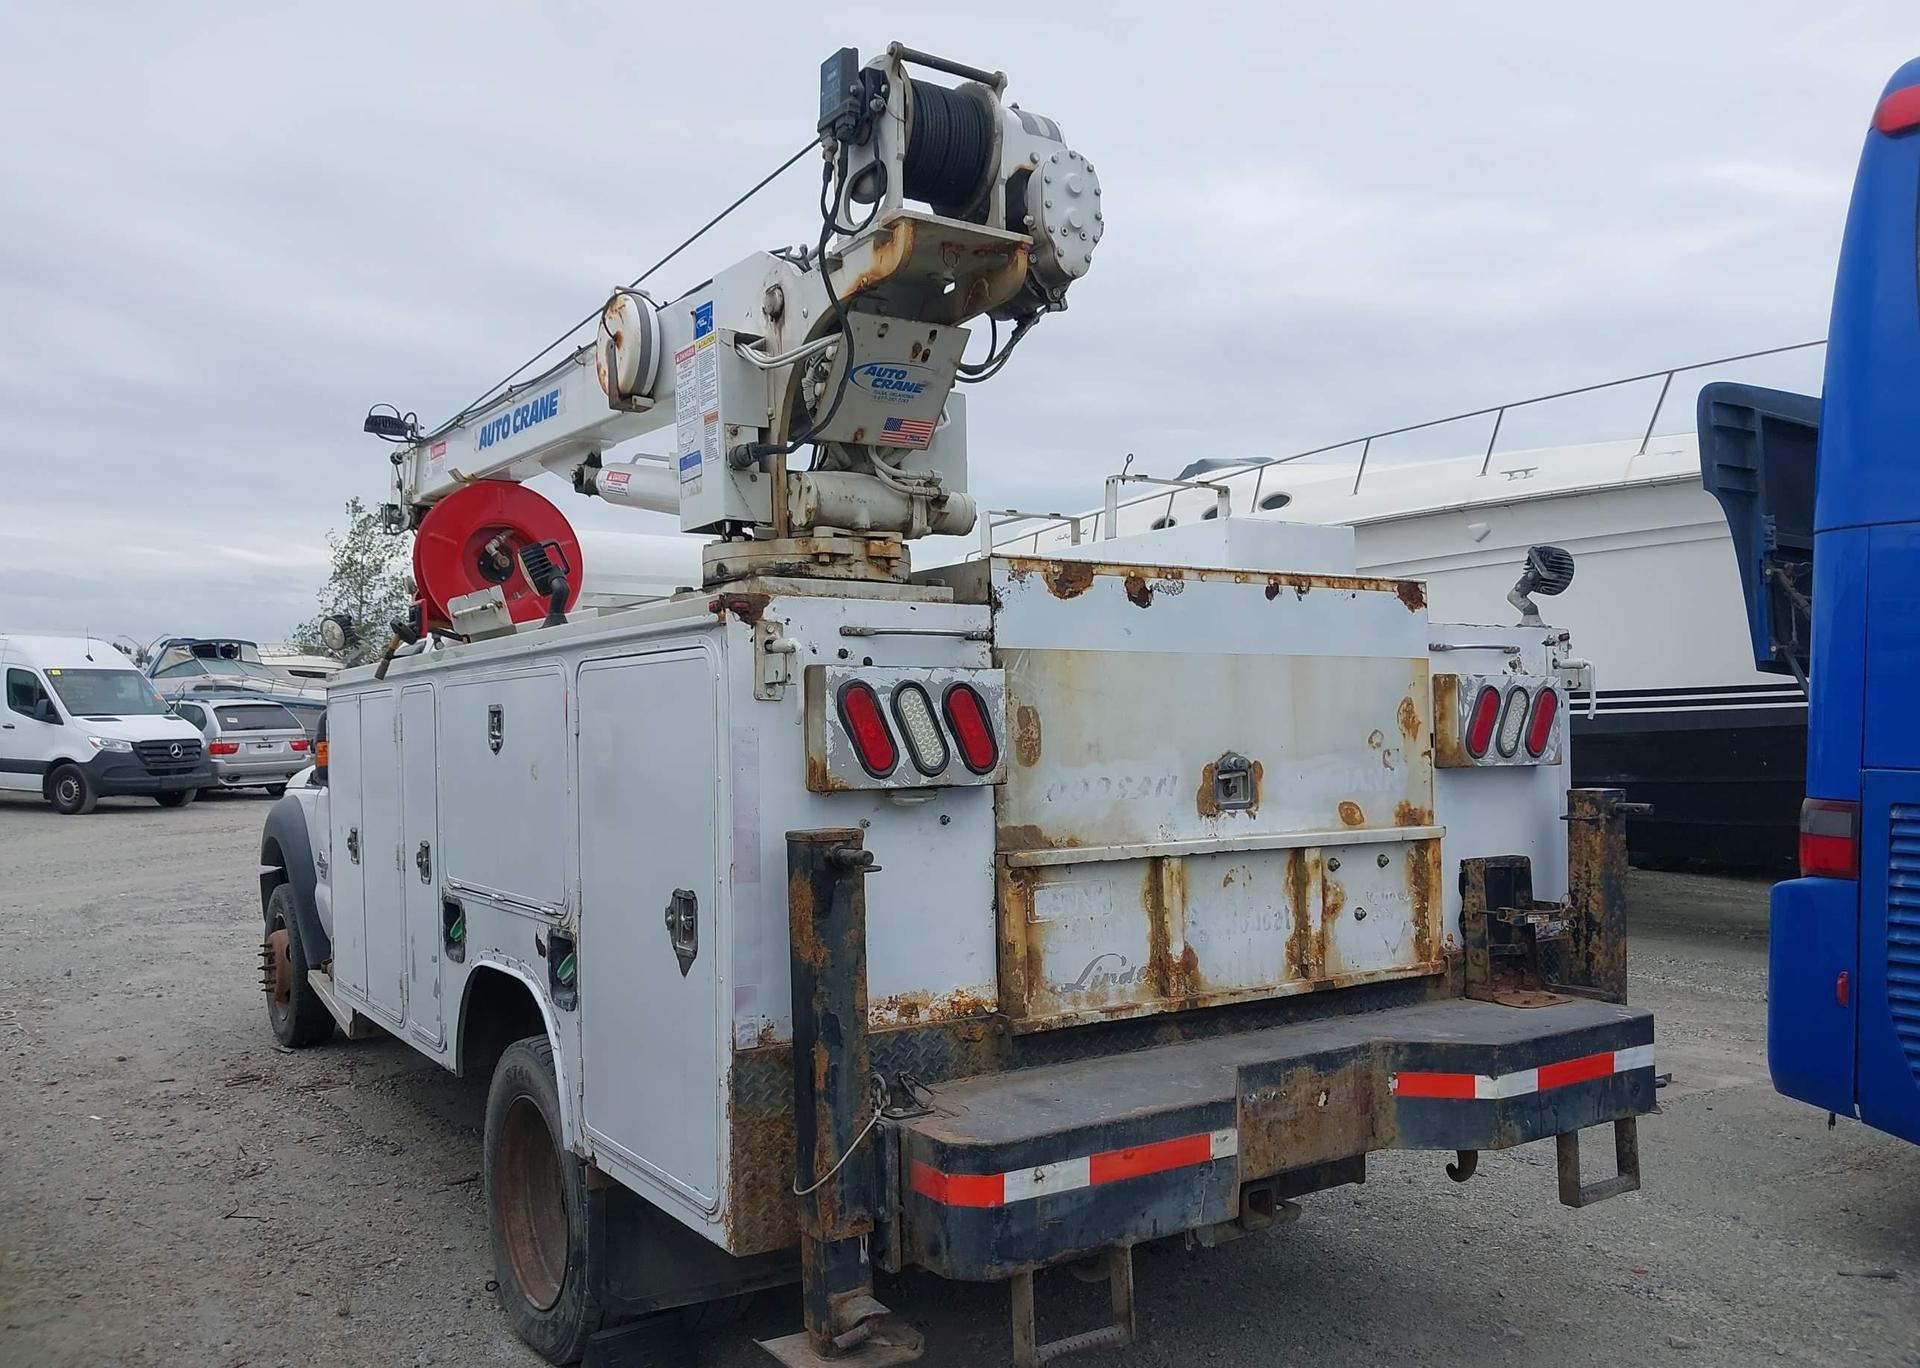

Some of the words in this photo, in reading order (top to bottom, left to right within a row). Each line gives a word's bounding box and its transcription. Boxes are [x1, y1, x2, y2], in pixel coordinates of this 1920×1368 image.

[863, 366, 907, 380] AUTO
[871, 379, 927, 393] CRANE
[478, 413, 510, 450] AUTO
[513, 390, 559, 433] CRANE
